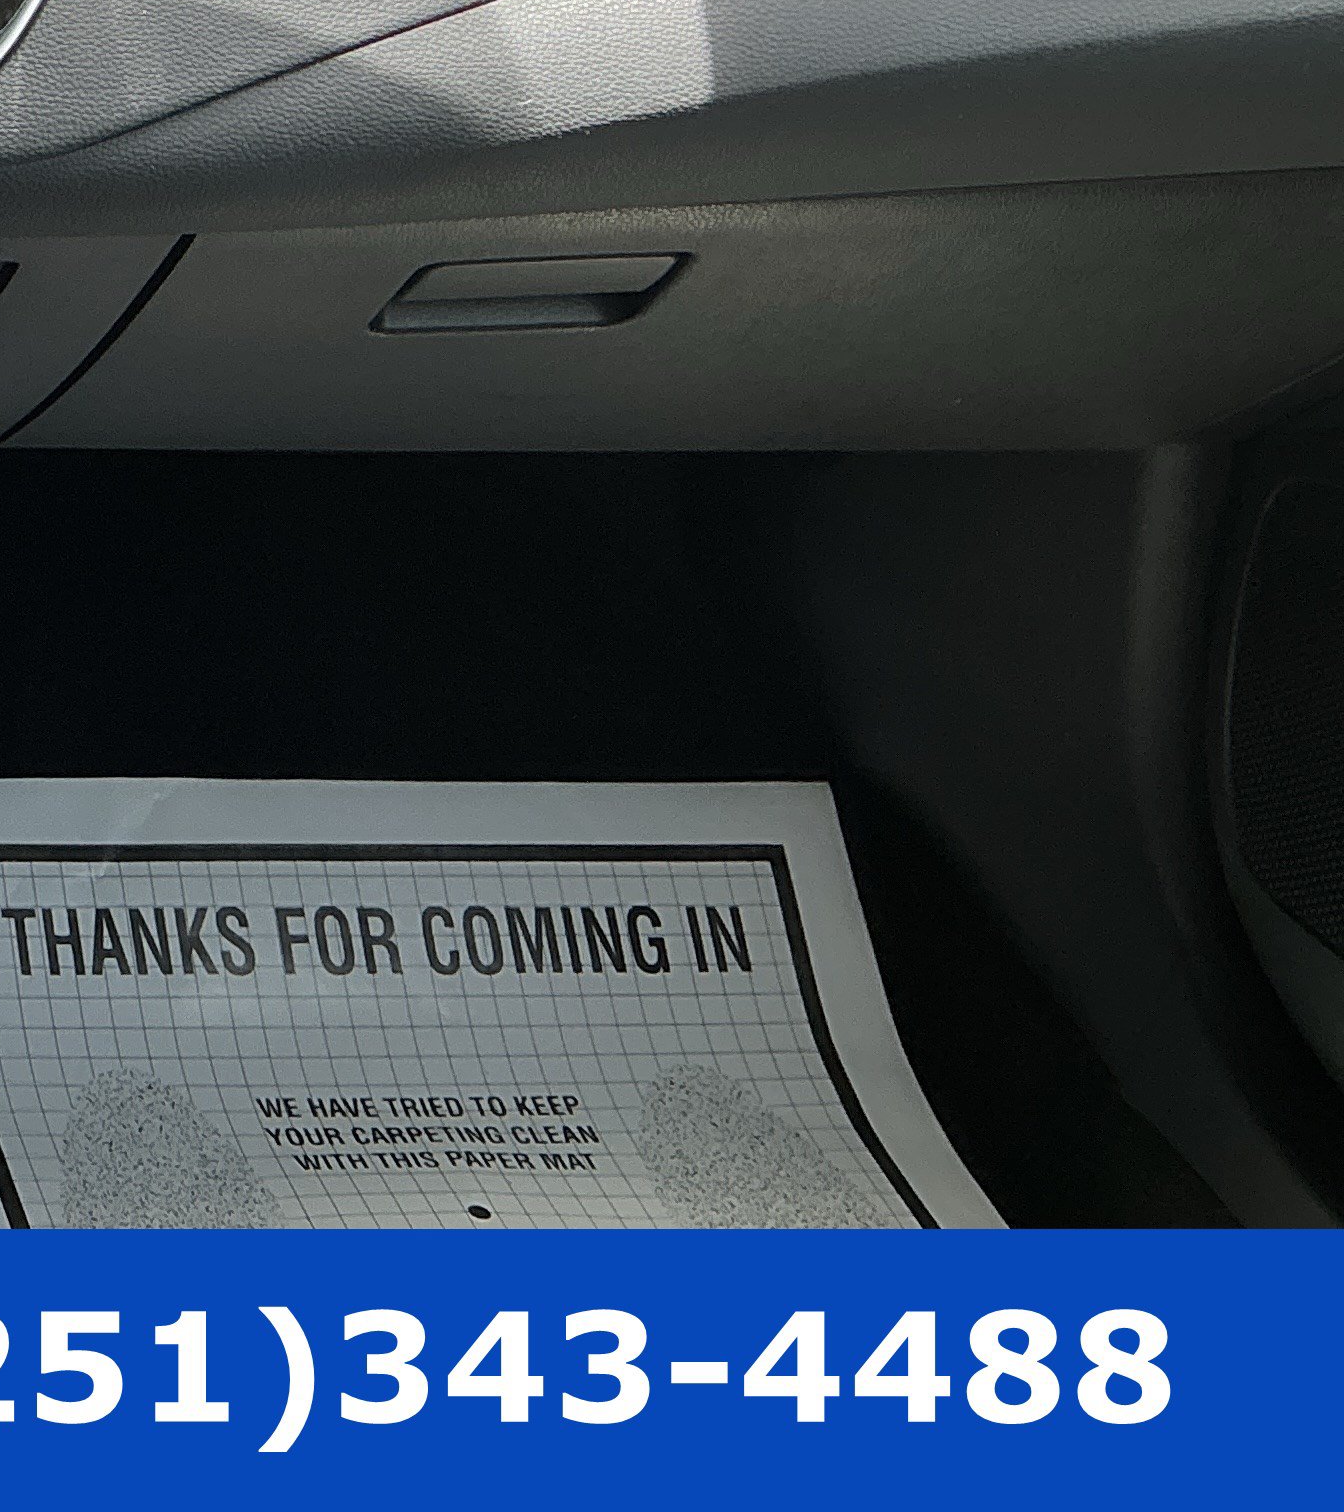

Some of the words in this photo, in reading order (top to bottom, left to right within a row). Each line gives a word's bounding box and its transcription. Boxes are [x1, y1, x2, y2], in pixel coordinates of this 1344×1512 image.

[1, 906, 256, 976] THANKS
[275, 905, 404, 976] FOR
[421, 905, 671, 976] COMING
[686, 905, 753, 973] IN
[256, 1097, 302, 1118] WE
[307, 1097, 380, 1118] HAVE
[384, 1096, 464, 1118] TRIED
[468, 1096, 507, 1117] TO
[513, 1095, 579, 1116] KEEP
[264, 1127, 342, 1147] YOUR
[350, 1125, 507, 1145] CARPETING
[512, 1124, 602, 1145] CLEAN
[293, 1153, 370, 1172] WITH
[372, 1152, 441, 1170] THIS
[446, 1151, 537, 1171] PAPER
[542, 1152, 598, 1171] MAT
